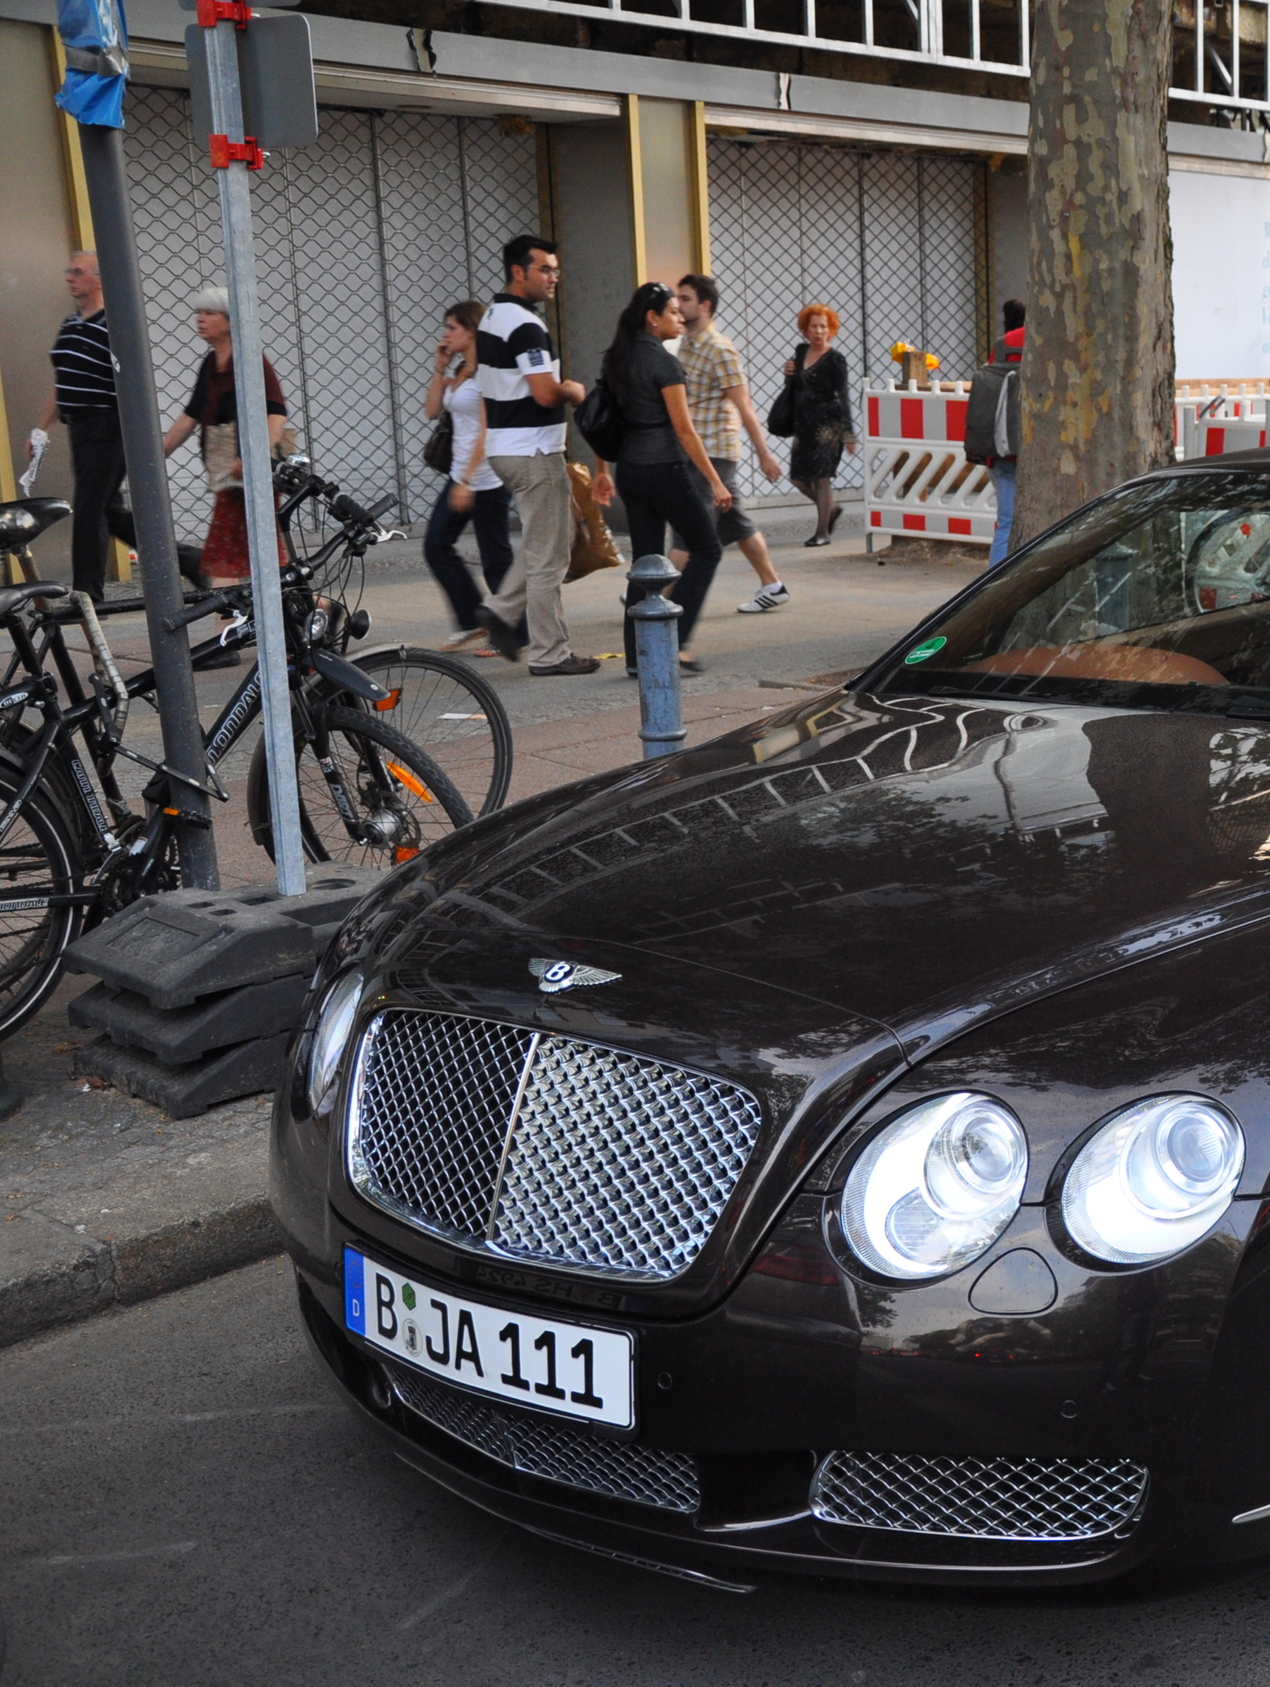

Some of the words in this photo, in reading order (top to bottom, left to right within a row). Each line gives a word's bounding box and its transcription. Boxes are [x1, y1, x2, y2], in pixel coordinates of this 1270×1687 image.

[545, 961, 571, 981] B
[376, 1272, 398, 1341] B
[425, 1298, 485, 1378] JA
[499, 1322, 604, 1409] 111
